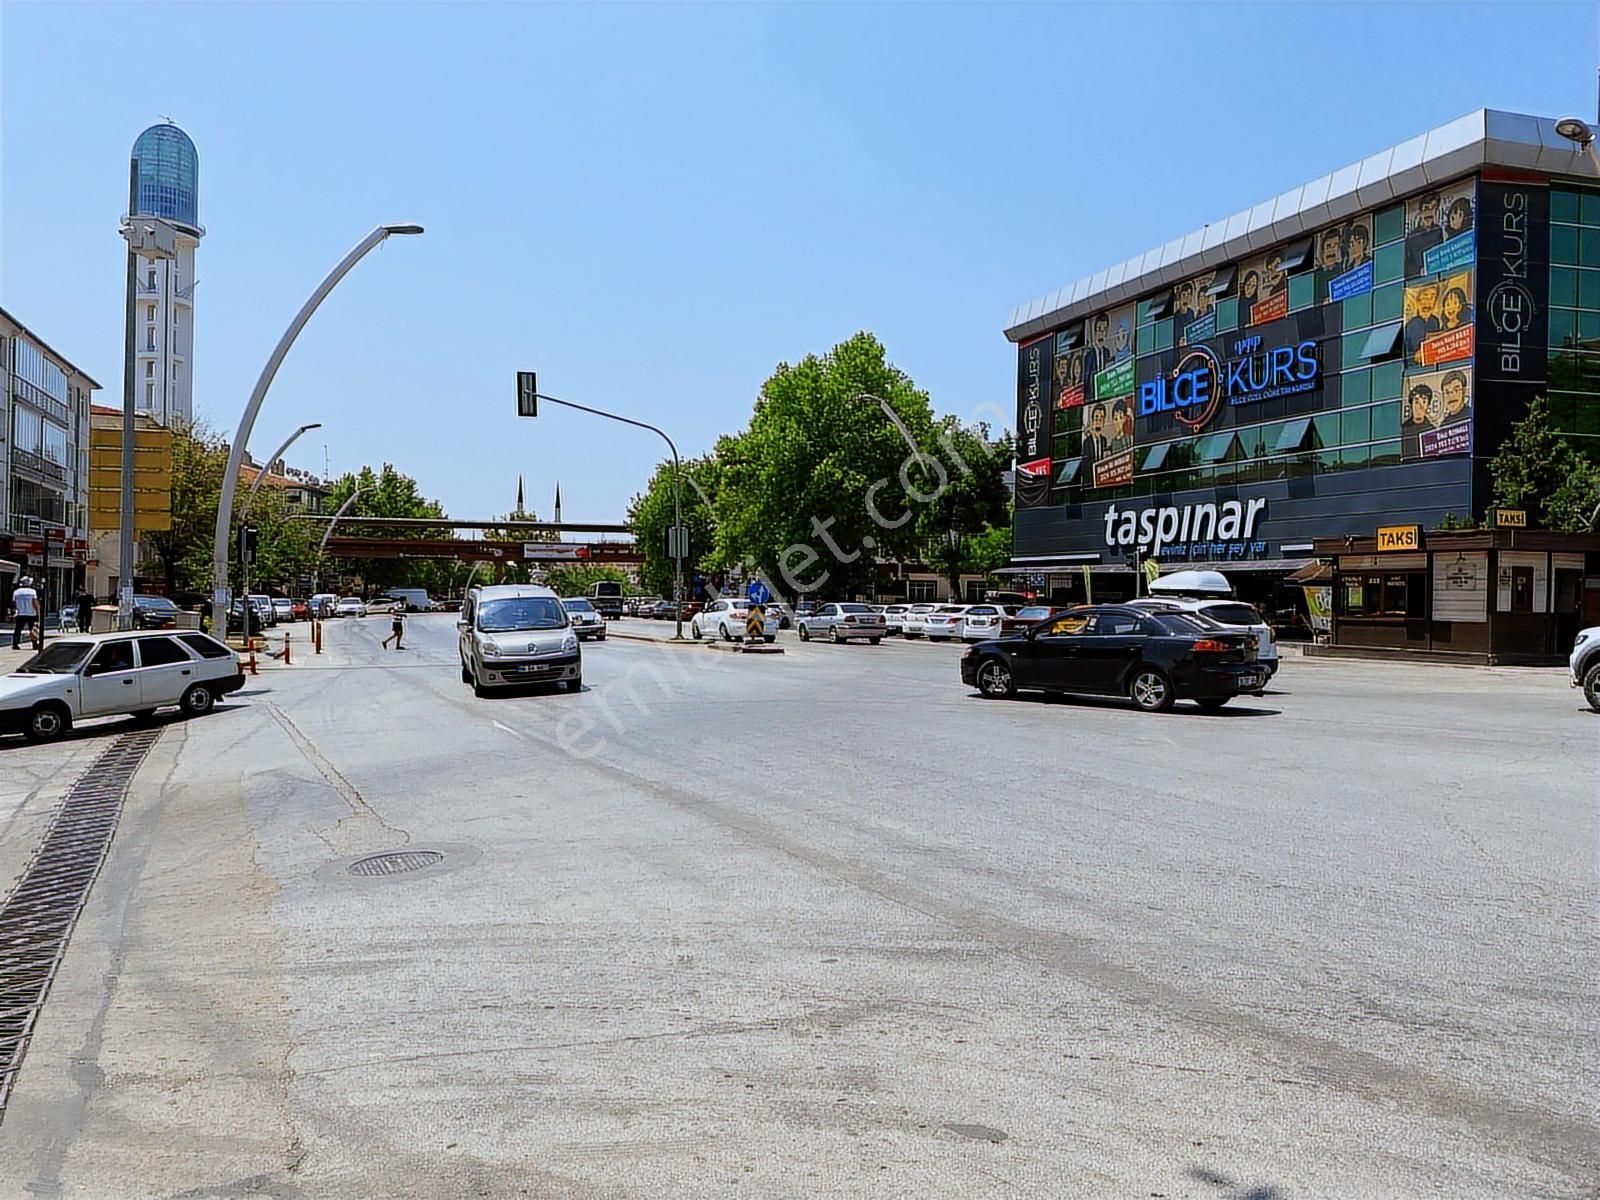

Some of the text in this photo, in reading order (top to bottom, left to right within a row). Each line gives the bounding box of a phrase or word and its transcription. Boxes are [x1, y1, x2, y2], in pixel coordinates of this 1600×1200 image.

[1497, 192, 1524, 372] BİLCE KURS
[1028, 347, 1041, 400] KURS
[1140, 368, 1209, 416] BİLCE
[1228, 342, 1318, 397] KURS
[1104, 498, 1265, 556] taşpınar
[1379, 528, 1417, 547] TAKSİ
[1498, 510, 1525, 525] TAKSİ
